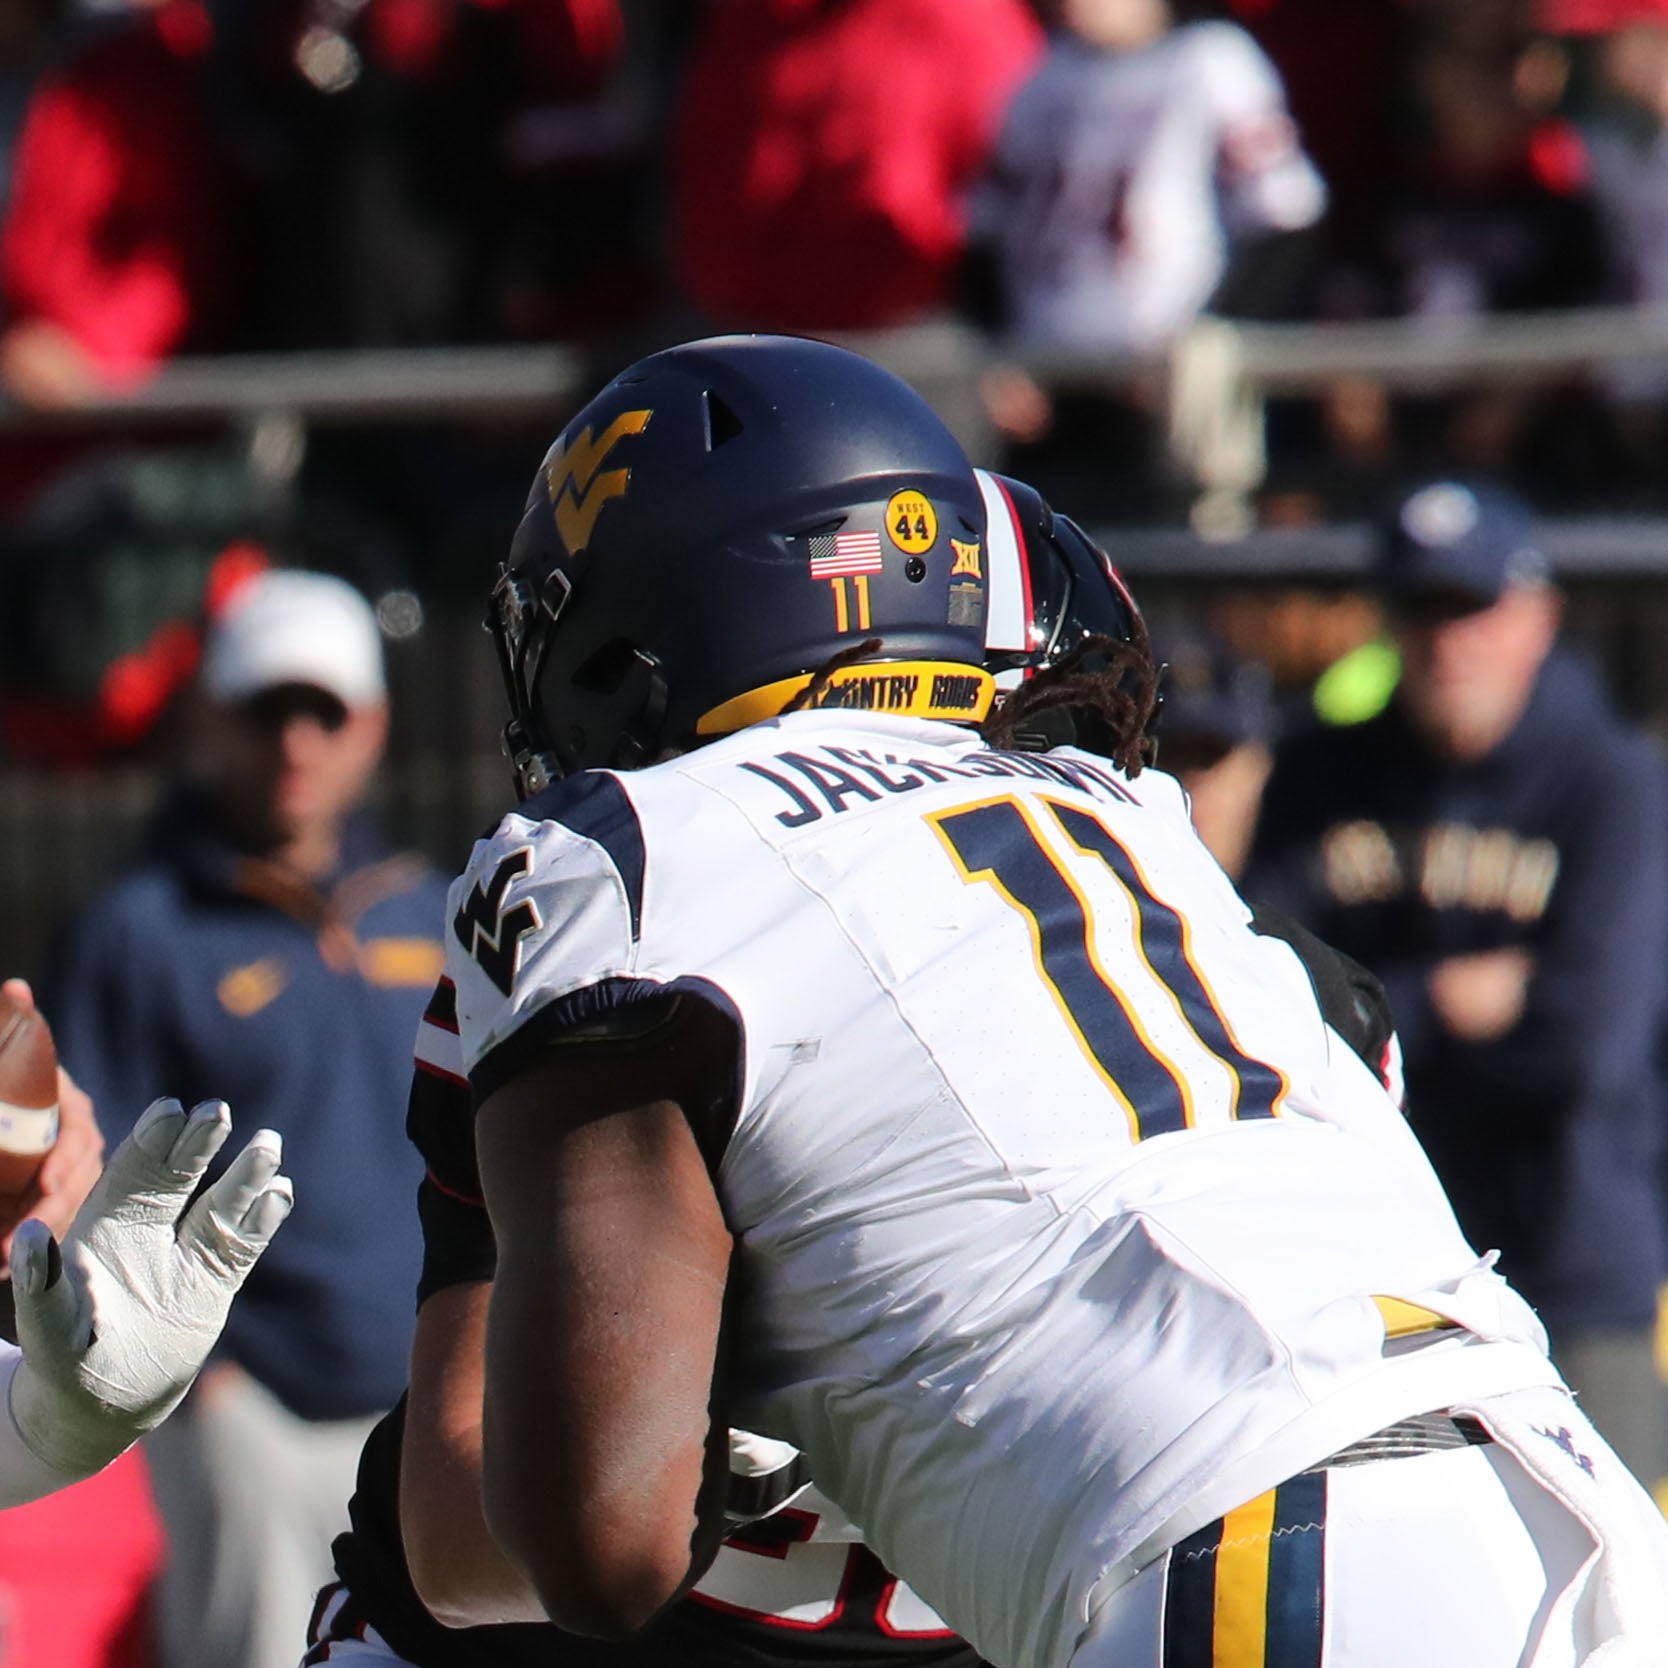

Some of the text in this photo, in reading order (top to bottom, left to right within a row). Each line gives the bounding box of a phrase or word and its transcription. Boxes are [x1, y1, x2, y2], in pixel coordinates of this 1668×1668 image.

[895, 514, 929, 541] 44
[896, 502, 925, 514] WEST
[831, 574, 870, 633] 11
[922, 793, 1291, 1146] 11
